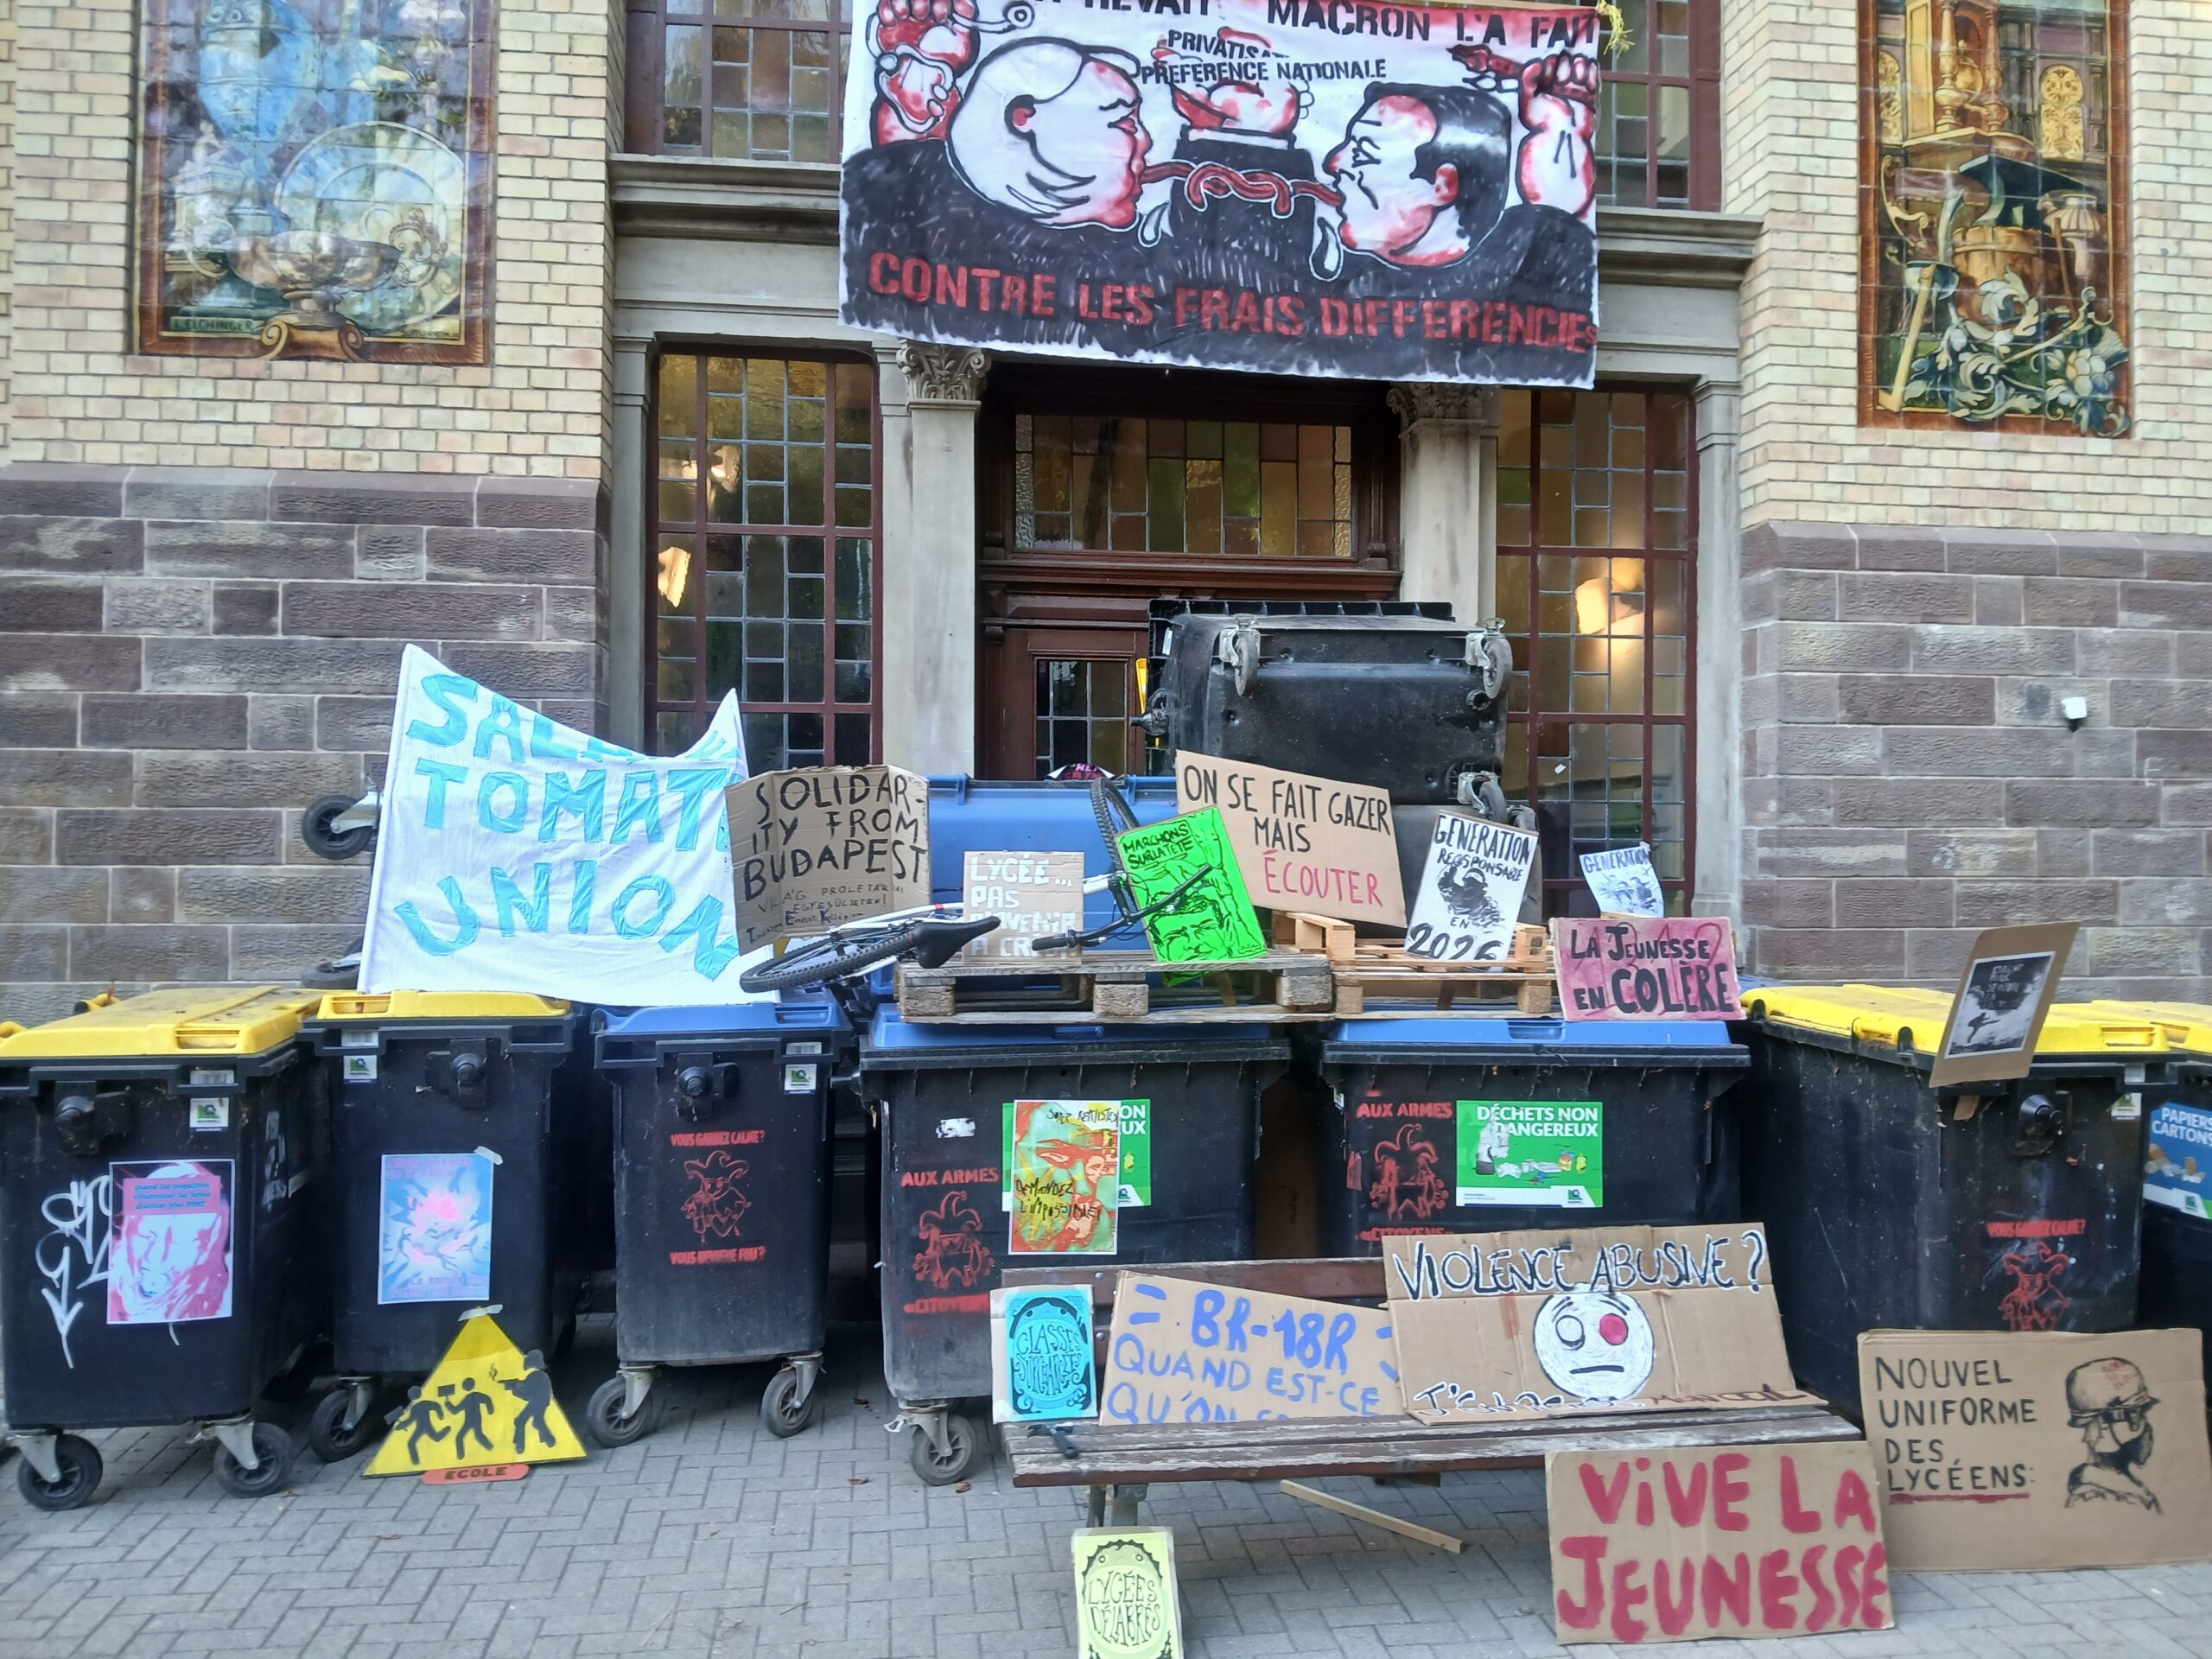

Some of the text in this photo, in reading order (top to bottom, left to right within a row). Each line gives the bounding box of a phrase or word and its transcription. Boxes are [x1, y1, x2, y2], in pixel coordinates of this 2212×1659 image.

[1268, 0, 1430, 41] MACRON
[1456, 12, 1506, 46] L'A
[1530, 13, 1596, 48] FAIT
[1277, 59, 1387, 81] NATIONALE
[869, 252, 1056, 317] CONTRE
[1079, 283, 1155, 326] LES
[1175, 287, 1306, 335] FRAIS
[756, 772, 924, 825] SOLIDAR-
[1184, 765, 1392, 836] ON SE FAIT GAZER
[753, 808, 918, 855] ITY FROM
[1123, 823, 1189, 855] MARCHONS
[1254, 817, 1312, 853] MAIS
[1435, 814, 1532, 866] GENERATION
[744, 839, 929, 901] BUDAPEST
[1262, 849, 1384, 907] ÉCOUTER
[969, 885, 1020, 909] PAS
[394, 860, 740, 982] UNION
[1450, 918, 1470, 929] EN
[1406, 922, 1504, 960] 2026
[1571, 929, 1602, 959] LA
[1573, 961, 1734, 1014] EN COLÈRE
[1119, 1120, 1147, 1135] UX
[1120, 1105, 1146, 1119] ON
[1356, 1102, 1453, 1119] AUX ARMES
[1477, 1103, 1599, 1122] DÉCHETS NON
[1495, 1122, 1599, 1138] DANGEREUX
[901, 1167, 1000, 1187] AUX ARMES
[1392, 1240, 1573, 1301] VIOLENCE
[1016, 1324, 1082, 1355] CLASSES
[1114, 1332, 1382, 1418] QUAND EST-CE
[1875, 1357, 2013, 1391] NOUVEL
[1878, 1396, 2037, 1428] UNIFORME
[1885, 1438, 1944, 1464] DES
[444, 1466, 508, 1480] ECOLE
[1780, 1455, 1877, 1534] LA
[1089, 1570, 1157, 1605] LYCÉES
[1557, 1535, 1888, 1642] JEUNESSE
[1090, 1603, 1160, 1647] DÉLABRÉS
